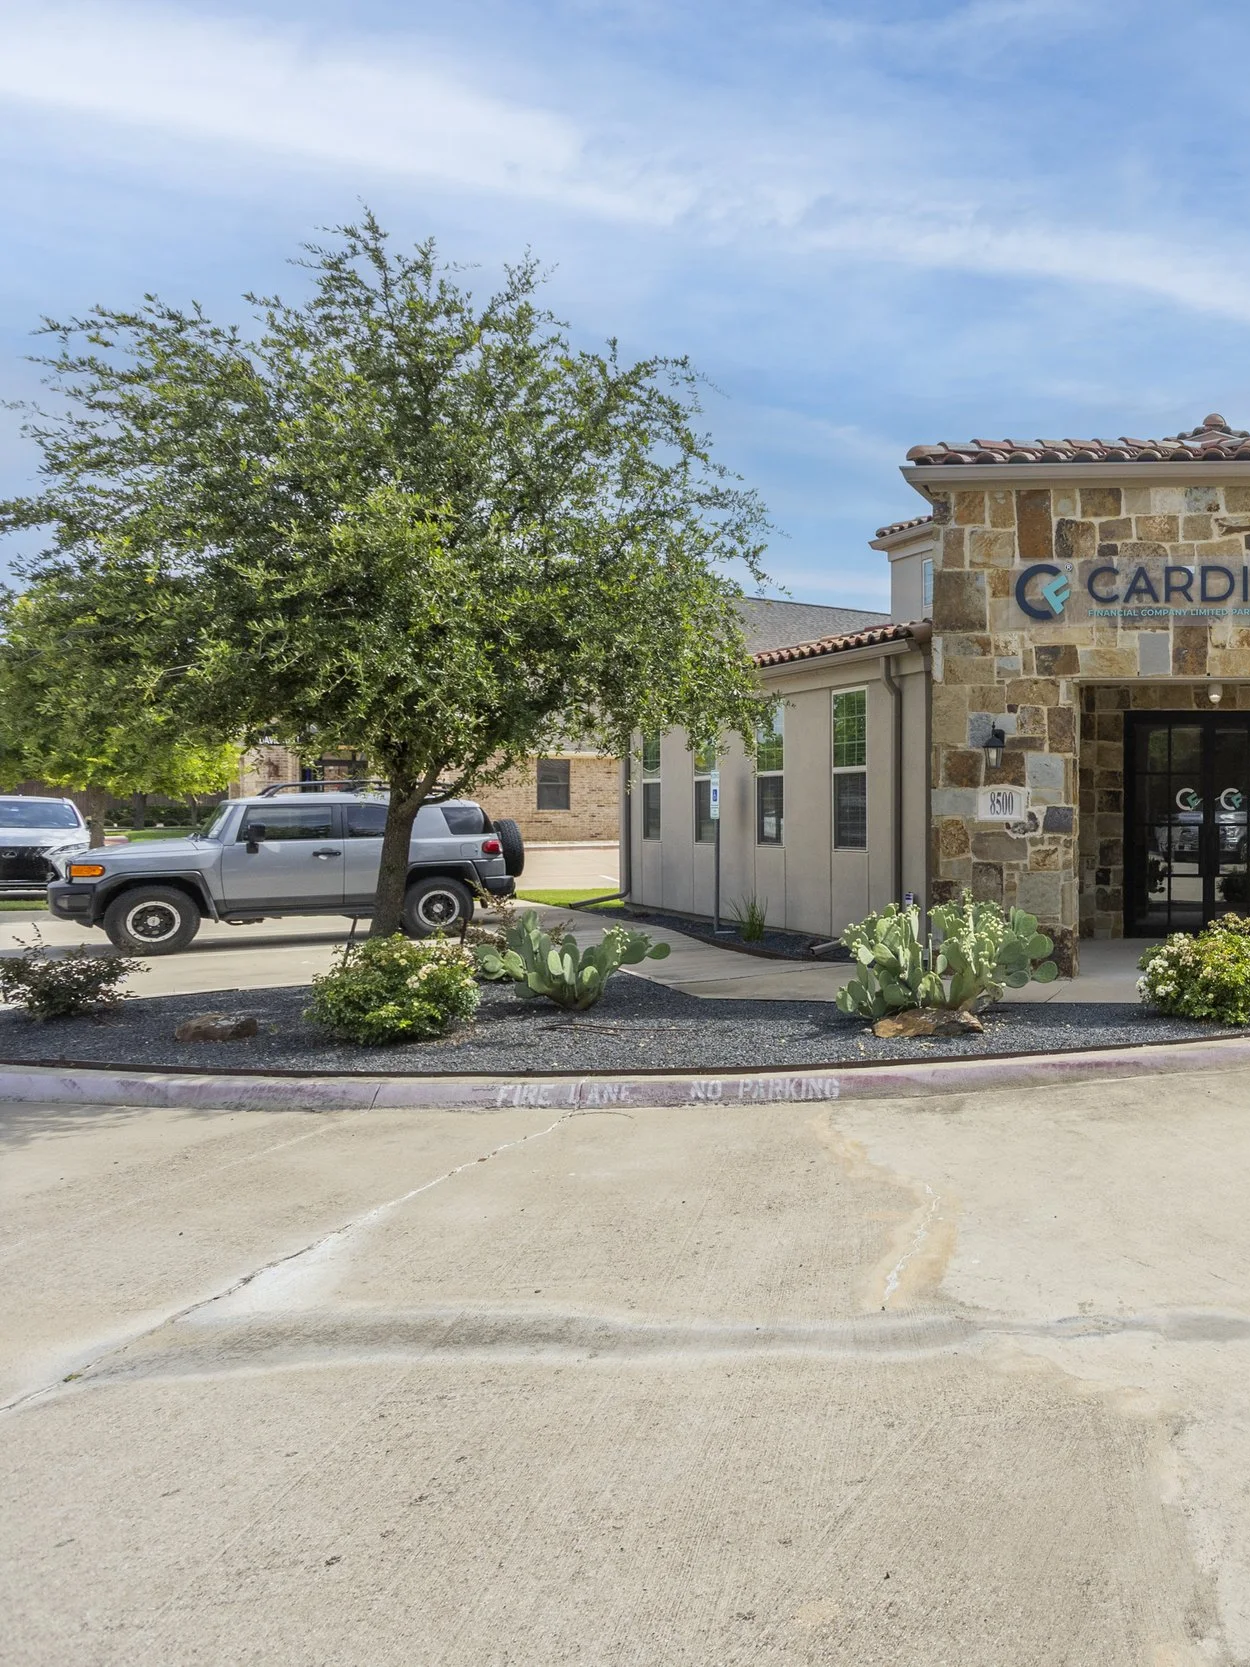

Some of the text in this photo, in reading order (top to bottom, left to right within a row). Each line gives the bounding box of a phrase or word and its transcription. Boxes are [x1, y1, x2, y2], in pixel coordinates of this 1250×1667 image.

[1088, 609, 1138, 617] FINANCIAL
[1141, 608, 1187, 616] COMPANY
[1191, 608, 1228, 616] LIMITED
[990, 792, 1013, 815] 8500
[498, 1083, 633, 1106] FIRE LANE
[690, 1078, 840, 1099] NO PARKING
